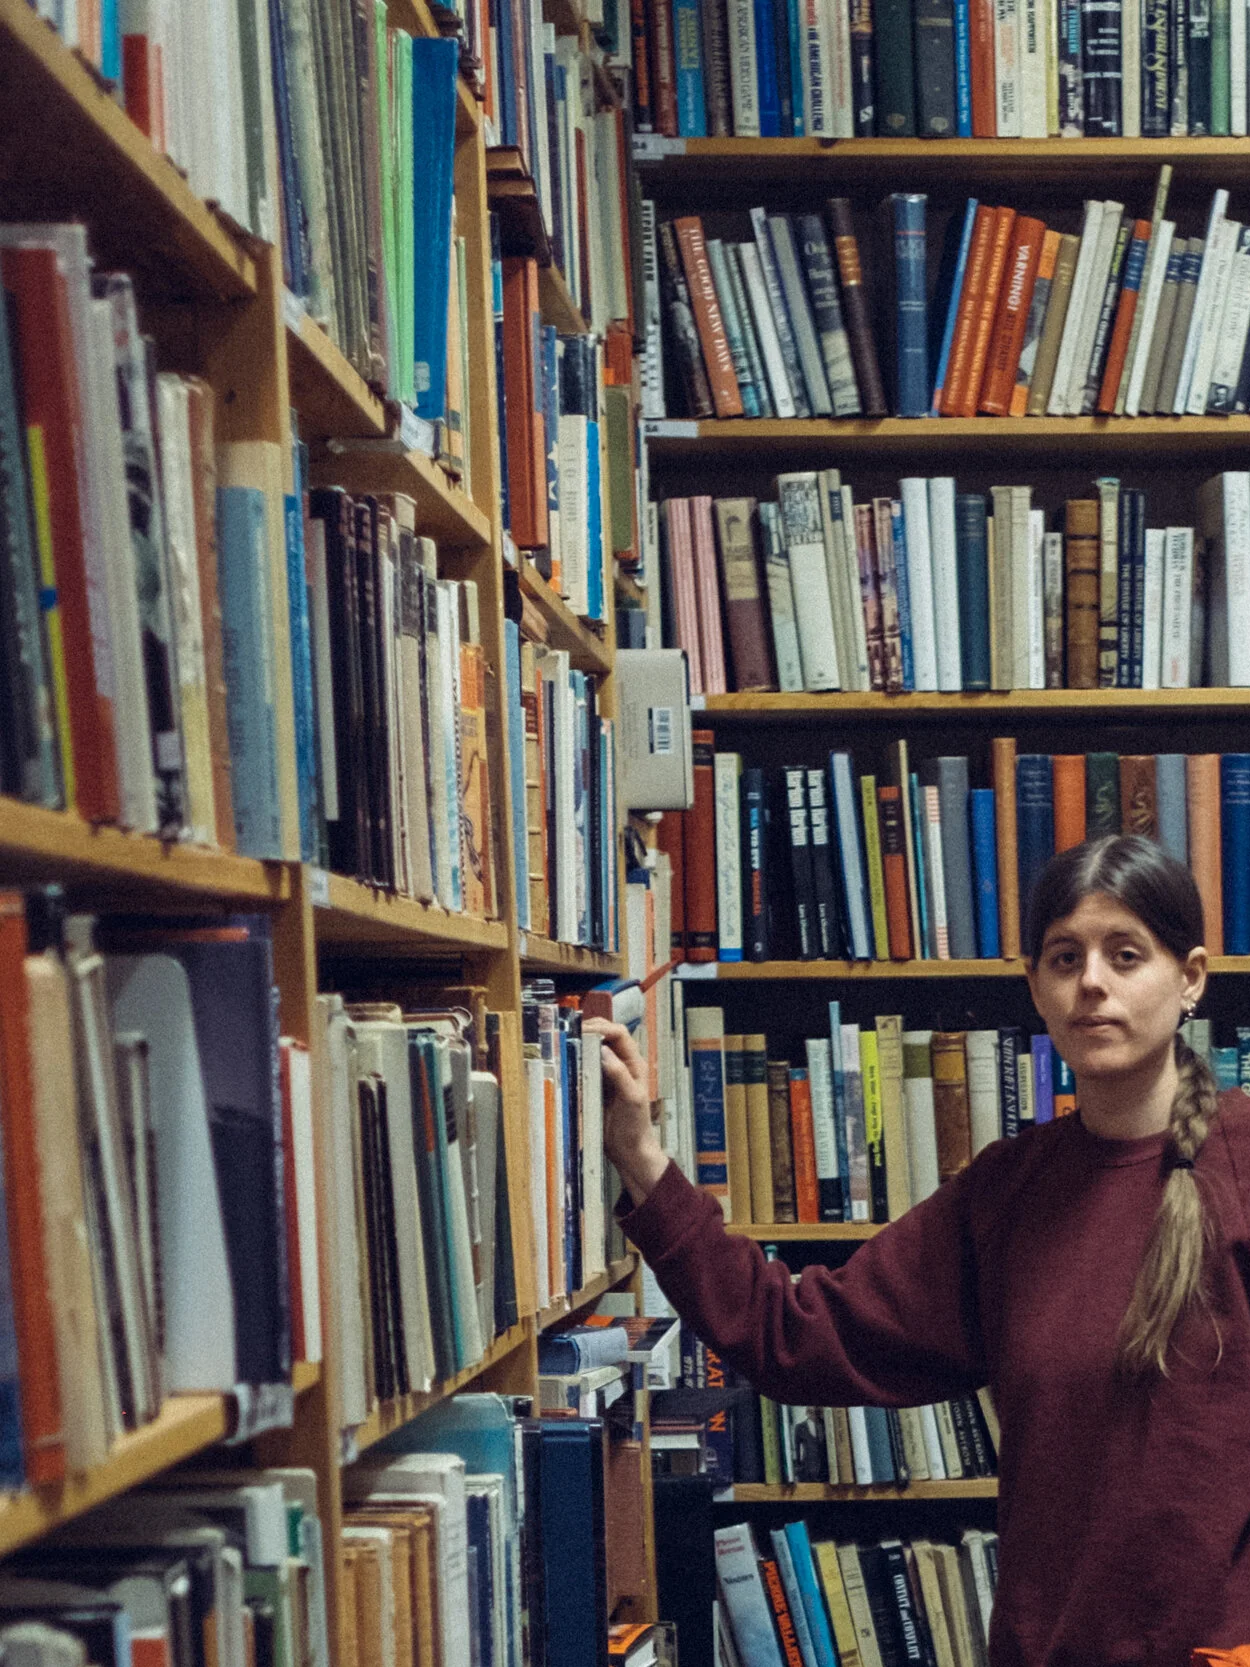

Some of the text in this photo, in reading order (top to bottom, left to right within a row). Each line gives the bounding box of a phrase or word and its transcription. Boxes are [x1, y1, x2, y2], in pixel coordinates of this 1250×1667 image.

[808, 43, 825, 131] AMERICAN CHALLENGE
[689, 226, 732, 373] THE GOOD NEW DAYS
[1006, 244, 1031, 312] VARNING!
[1121, 564, 1130, 659] THE STATUE OF LIBERTY
[1133, 564, 1144, 659] THE STATUE OF LIBERTY
[750, 807, 759, 829] USA
[750, 829, 759, 847] VID
[751, 848, 760, 870] ETT
[762, 1560, 788, 1614] PIERRE
[892, 1574, 921, 1661] CONFLICT and CONFLICT
